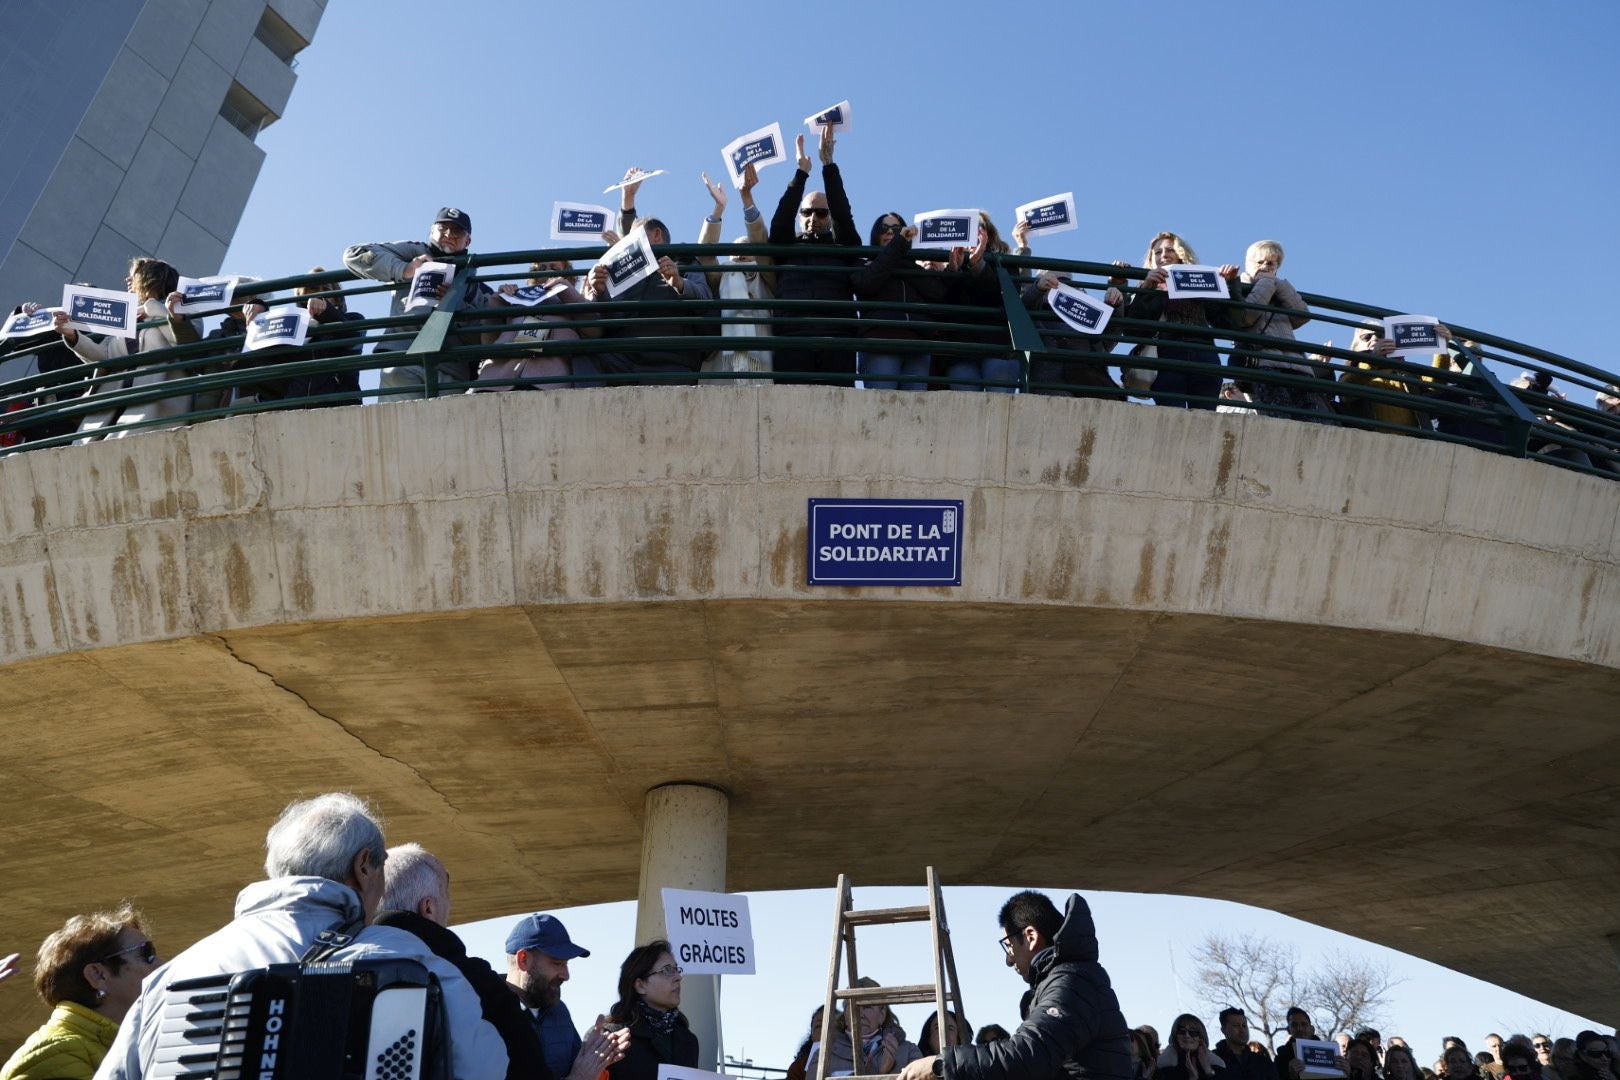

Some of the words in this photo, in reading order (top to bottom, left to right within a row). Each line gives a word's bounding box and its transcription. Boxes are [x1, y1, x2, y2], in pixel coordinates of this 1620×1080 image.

[745, 142, 761, 151] PONT
[746, 149, 755, 157] DE
[754, 147, 763, 155] LA
[447, 208, 460, 218] S
[1030, 214, 1065, 225] SOLIDARITAT
[93, 301, 113, 309] PONT
[1070, 306, 1081, 315] DE
[1073, 301, 1089, 312] PONT
[77, 311, 122, 323] SOLIDARITAT
[1058, 304, 1095, 325] SOLIDARITAT
[829, 523, 882, 540] PONT
[887, 524, 912, 540] DE
[918, 524, 941, 540] LA
[819, 546, 950, 562] SOLIDARITAT
[680, 906, 738, 928] MOLTES
[679, 939, 746, 964] GRÀCIES
